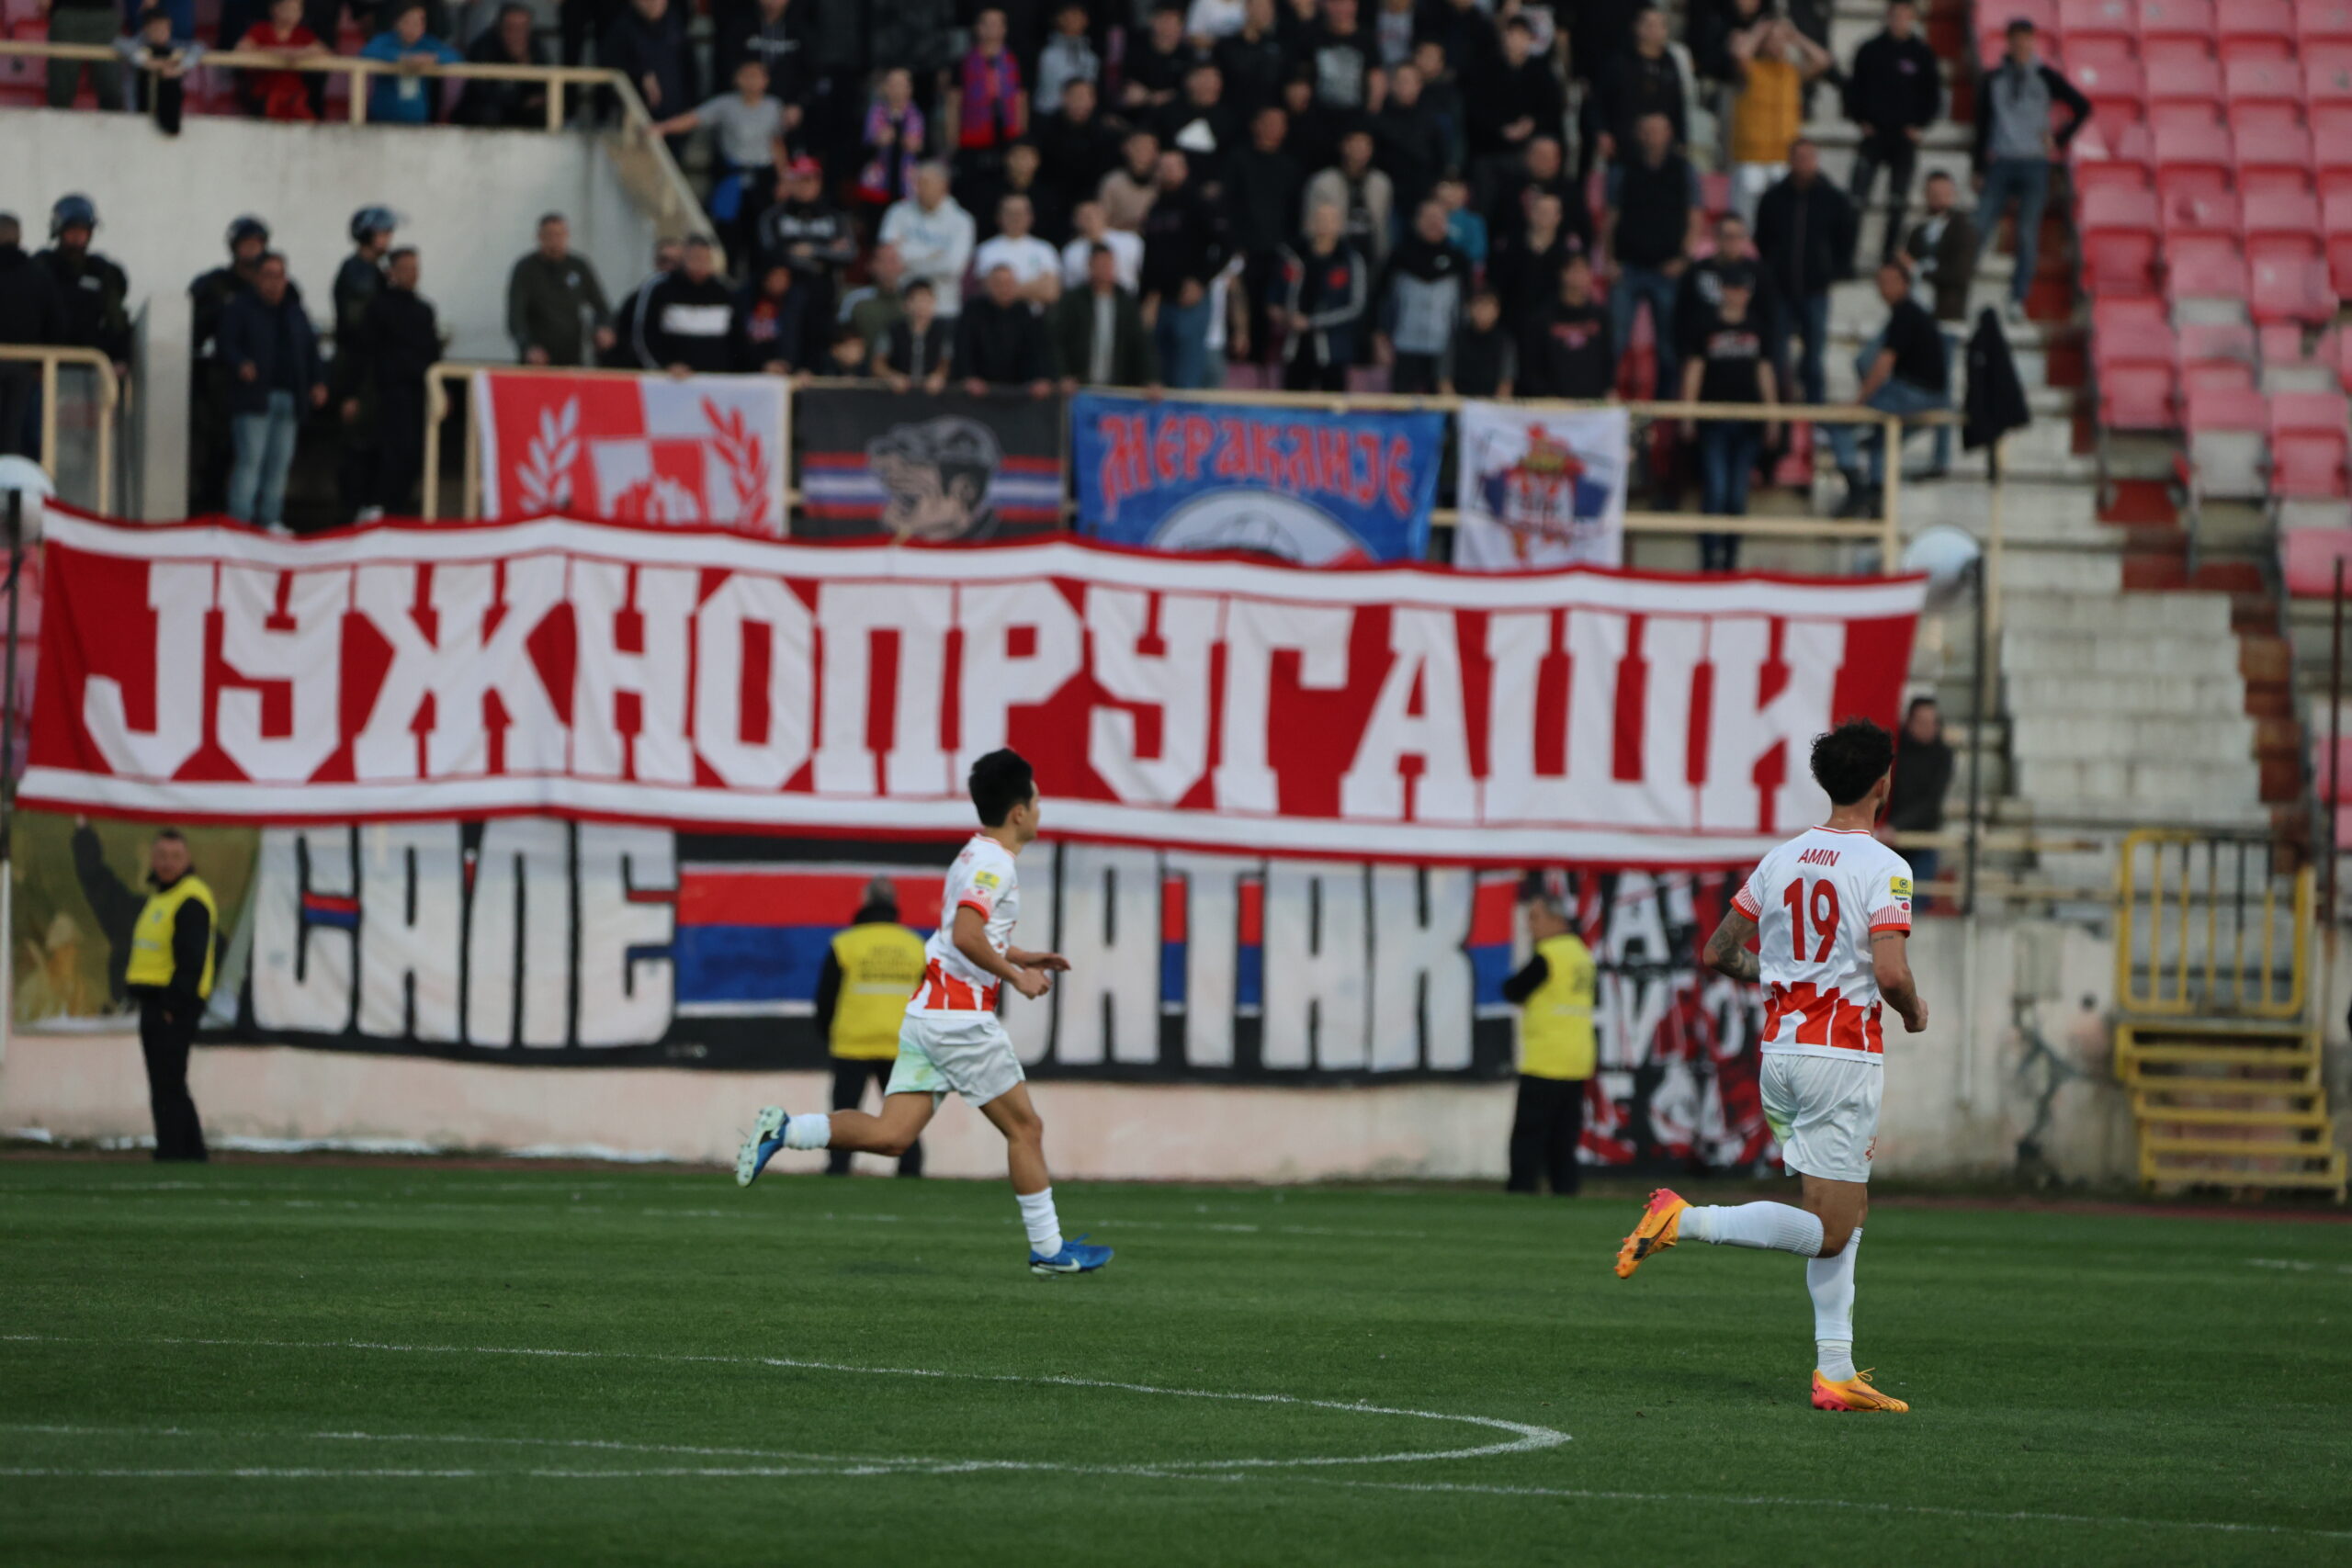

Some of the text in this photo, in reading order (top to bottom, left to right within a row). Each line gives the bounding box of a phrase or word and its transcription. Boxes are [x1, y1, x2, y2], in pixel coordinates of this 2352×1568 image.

[82, 554, 1847, 831] ЈУЖНОПРУГАШИ
[1797, 848, 1840, 867] AMIN
[1783, 877, 1840, 963] 19
